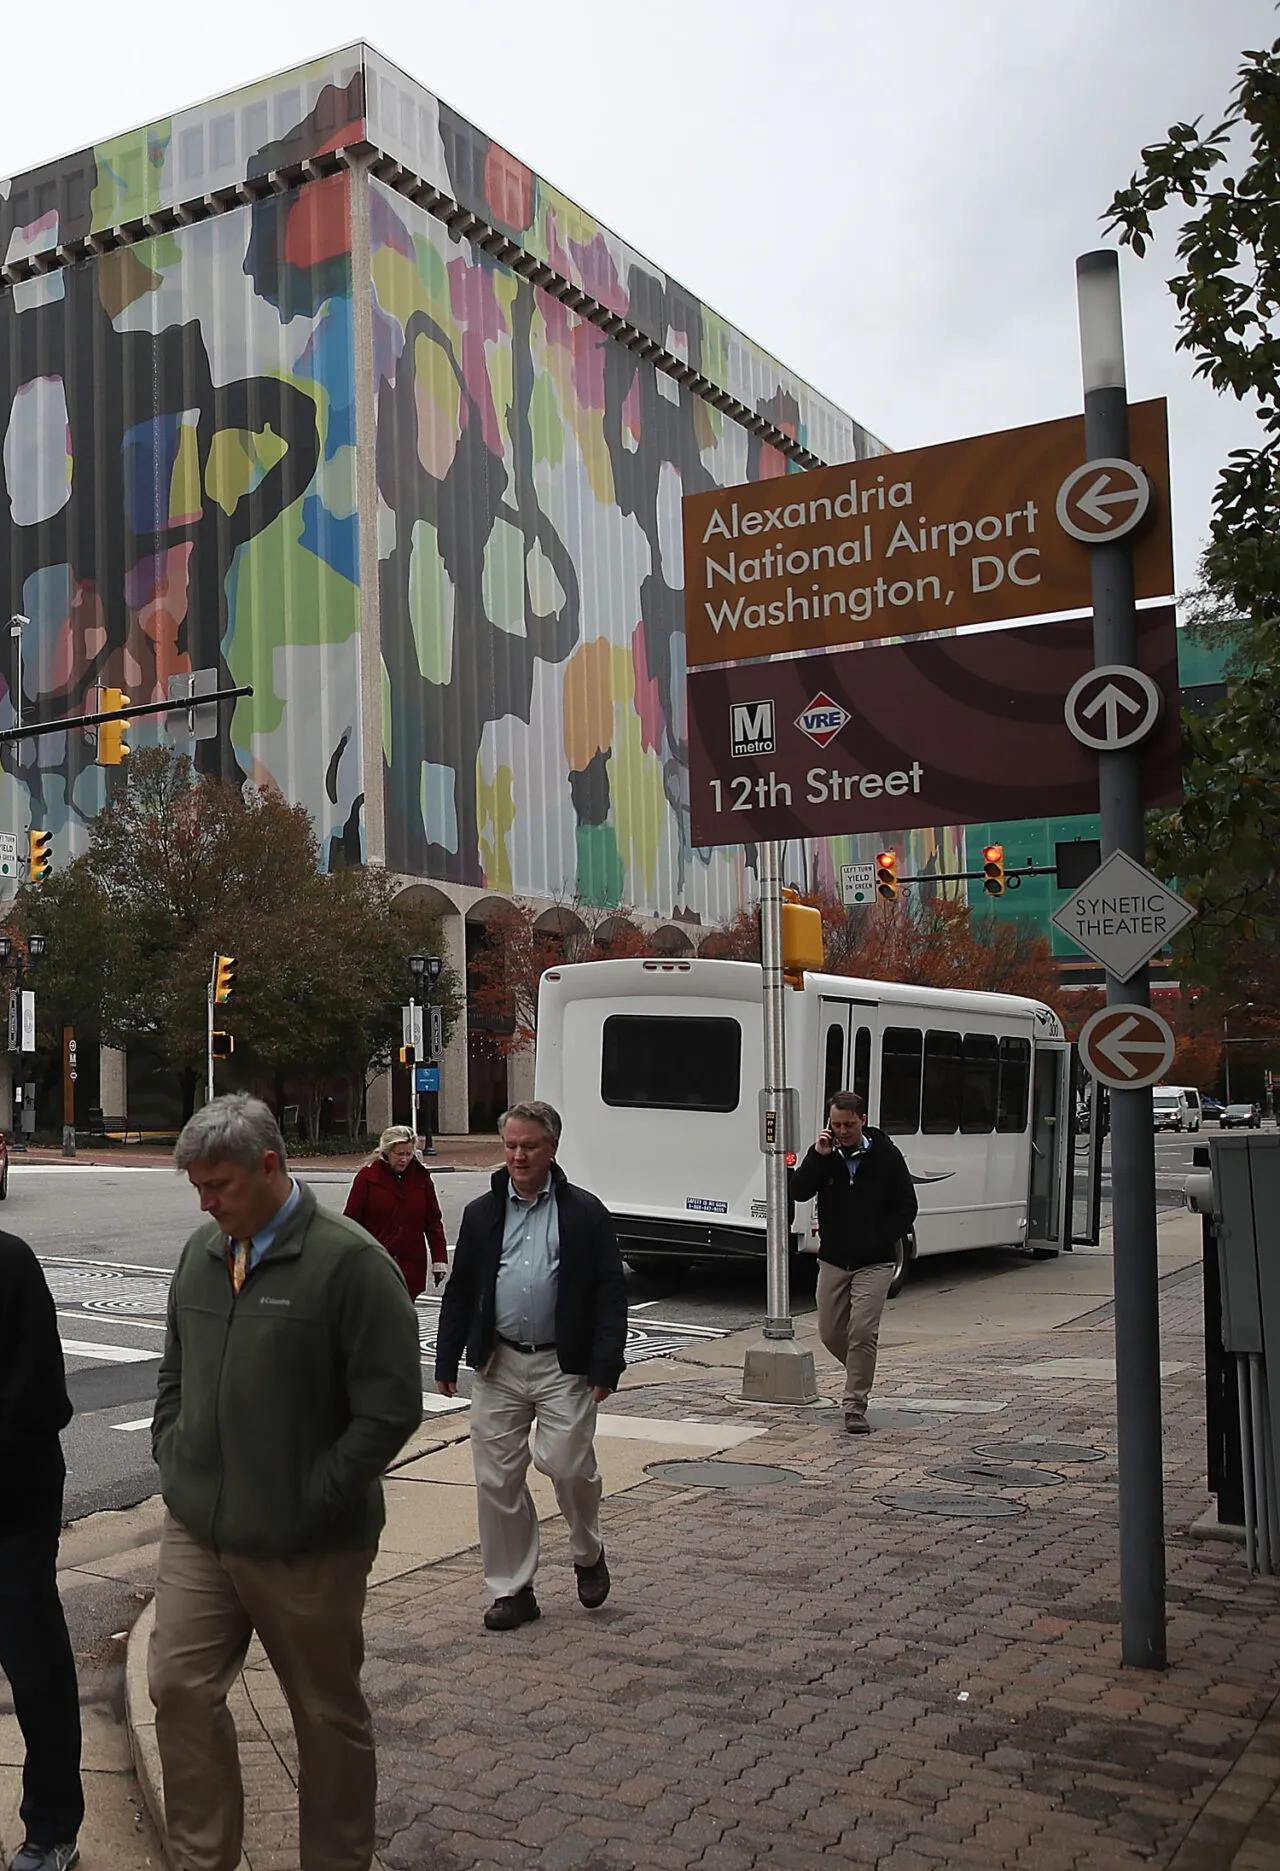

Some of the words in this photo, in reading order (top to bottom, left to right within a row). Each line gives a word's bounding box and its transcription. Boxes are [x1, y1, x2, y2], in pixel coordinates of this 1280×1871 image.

[702, 475, 913, 544] Alexandria
[706, 525, 872, 589] National
[885, 501, 1039, 558] Airport
[704, 574, 954, 635] Washington,
[972, 548, 1041, 594] DC
[733, 703, 772, 742] M
[803, 711, 841, 730] VRE
[735, 740, 773, 754] metro
[709, 771, 793, 813] 12th
[806, 761, 924, 804] Street
[847, 874, 870, 882] YIELD
[1075, 895, 1165, 916] SYNETIC
[1076, 916, 1167, 936] THEATER
